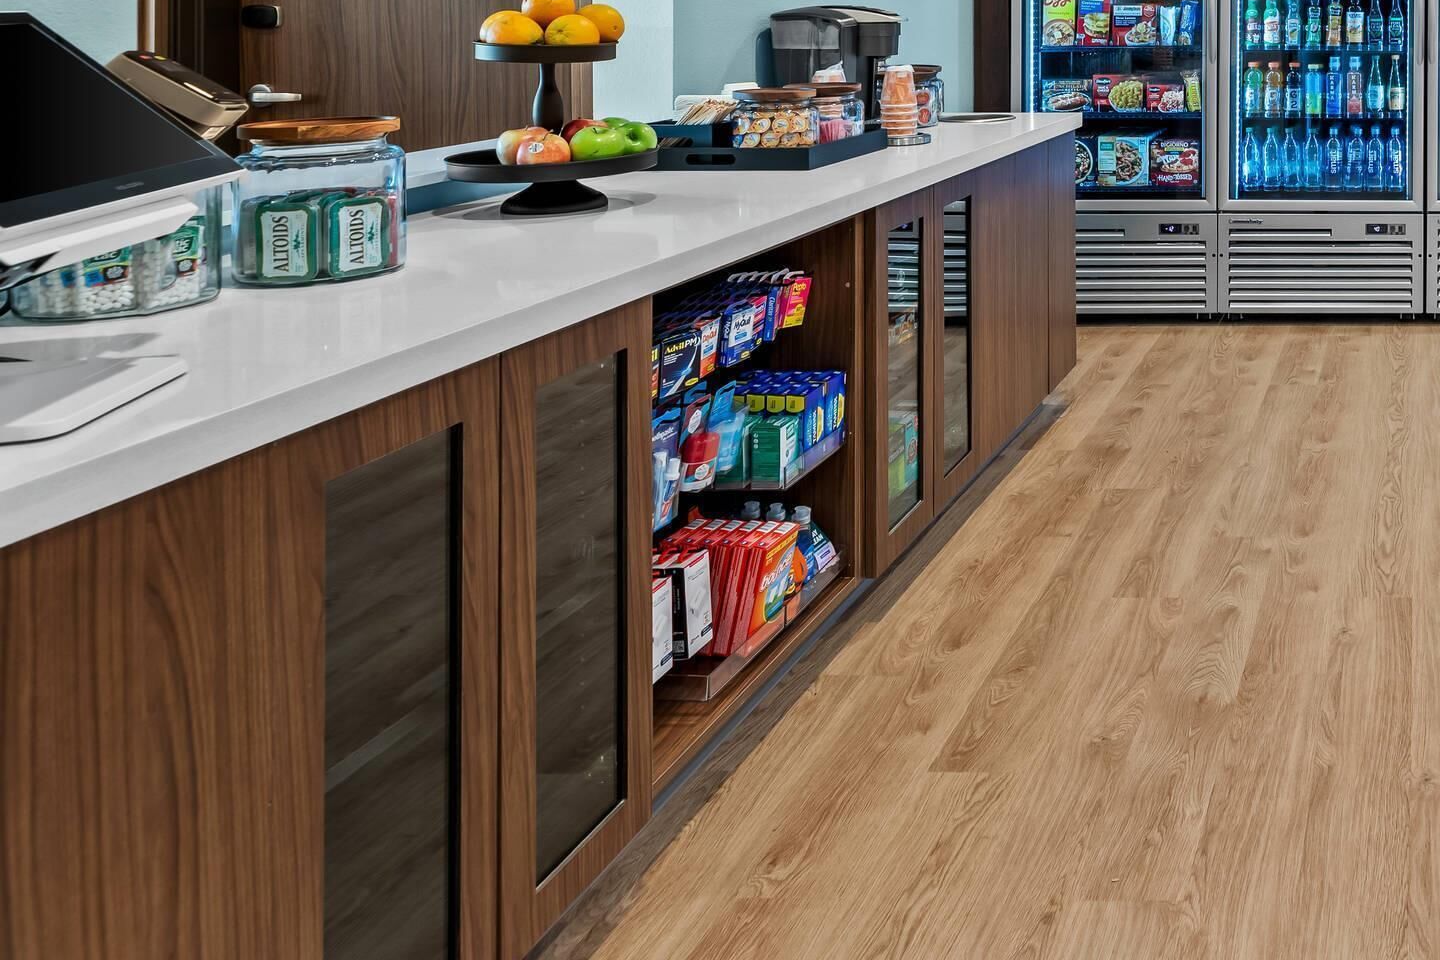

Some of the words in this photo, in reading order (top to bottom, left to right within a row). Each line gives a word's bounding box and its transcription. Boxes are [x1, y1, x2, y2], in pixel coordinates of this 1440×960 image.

[272, 215, 289, 273] ALTOIDS
[349, 208, 365, 265] ALTOIDS
[665, 341, 684, 354] Advil
[684, 338, 698, 347] PM
